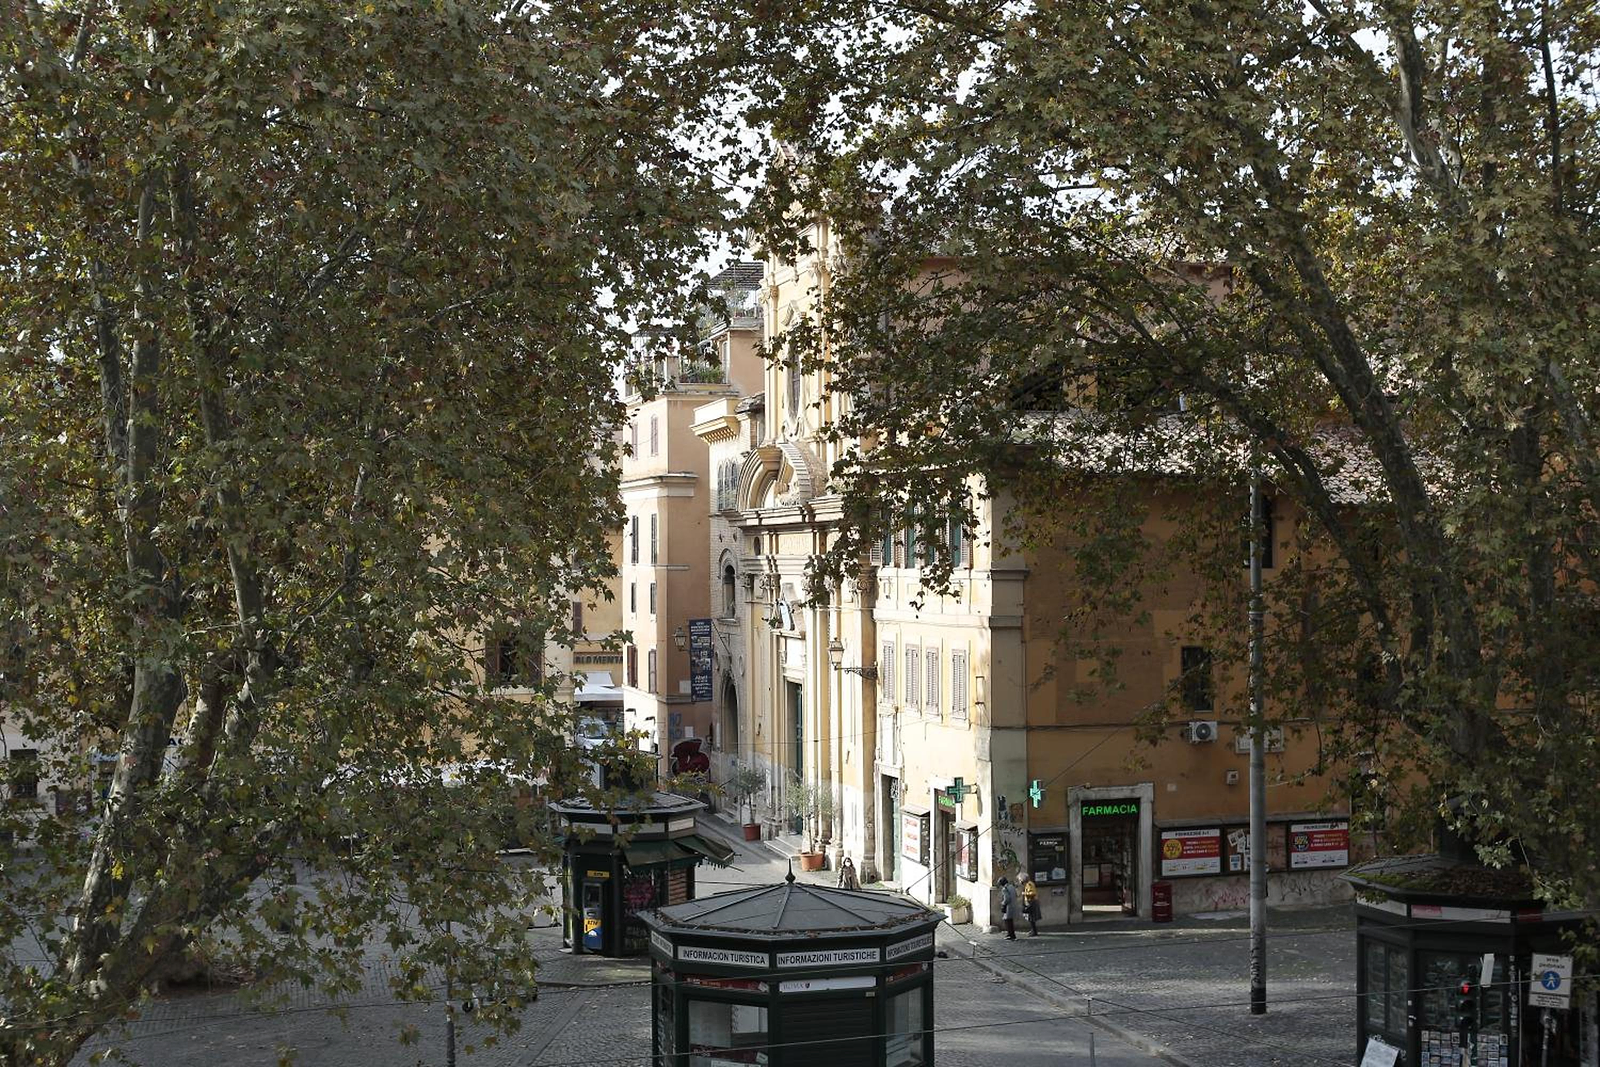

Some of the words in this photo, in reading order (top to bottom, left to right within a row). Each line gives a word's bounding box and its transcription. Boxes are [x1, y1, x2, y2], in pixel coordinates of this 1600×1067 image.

[1082, 804, 1138, 815] FARMACIA
[730, 952, 766, 965] TURISTICA
[778, 953, 832, 965] INFORMAZIONI
[834, 950, 877, 962] TURISTICHE
